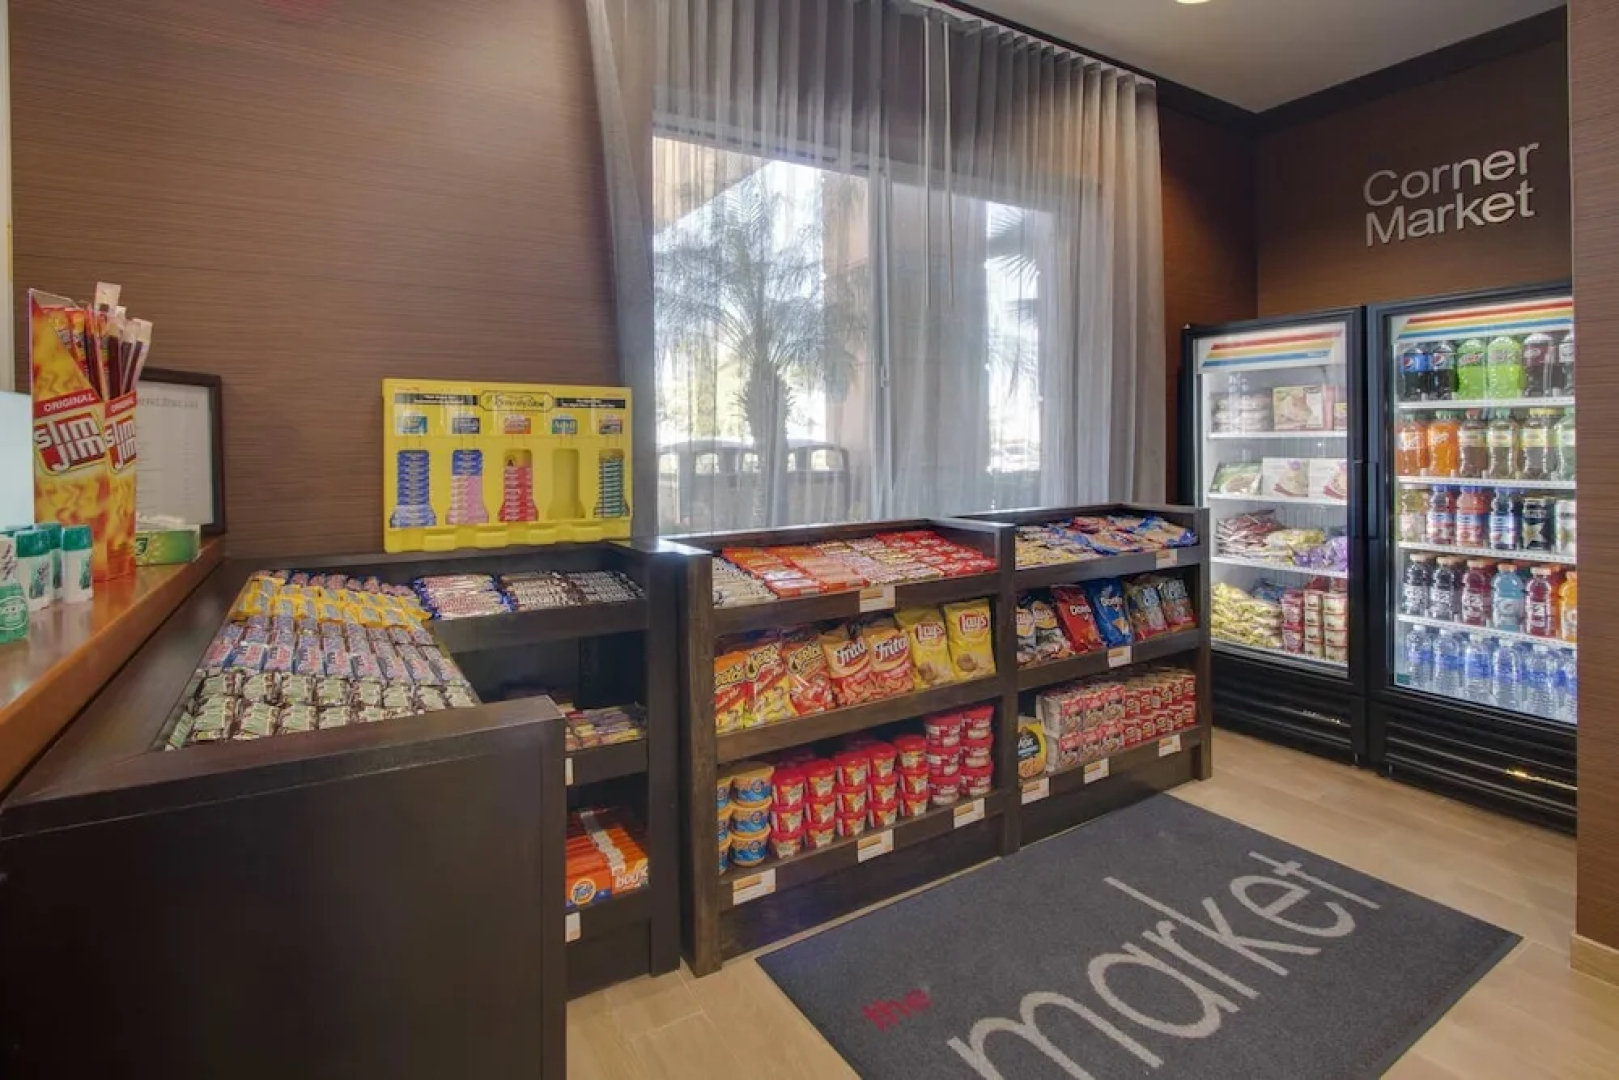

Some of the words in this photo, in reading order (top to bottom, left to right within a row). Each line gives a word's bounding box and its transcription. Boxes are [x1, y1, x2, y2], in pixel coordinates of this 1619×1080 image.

[1363, 142, 1540, 207] Corner
[1365, 179, 1536, 248] Market
[43, 393, 96, 412] ORIGINAL
[946, 850, 1381, 1080] market
[862, 987, 933, 1033] the
